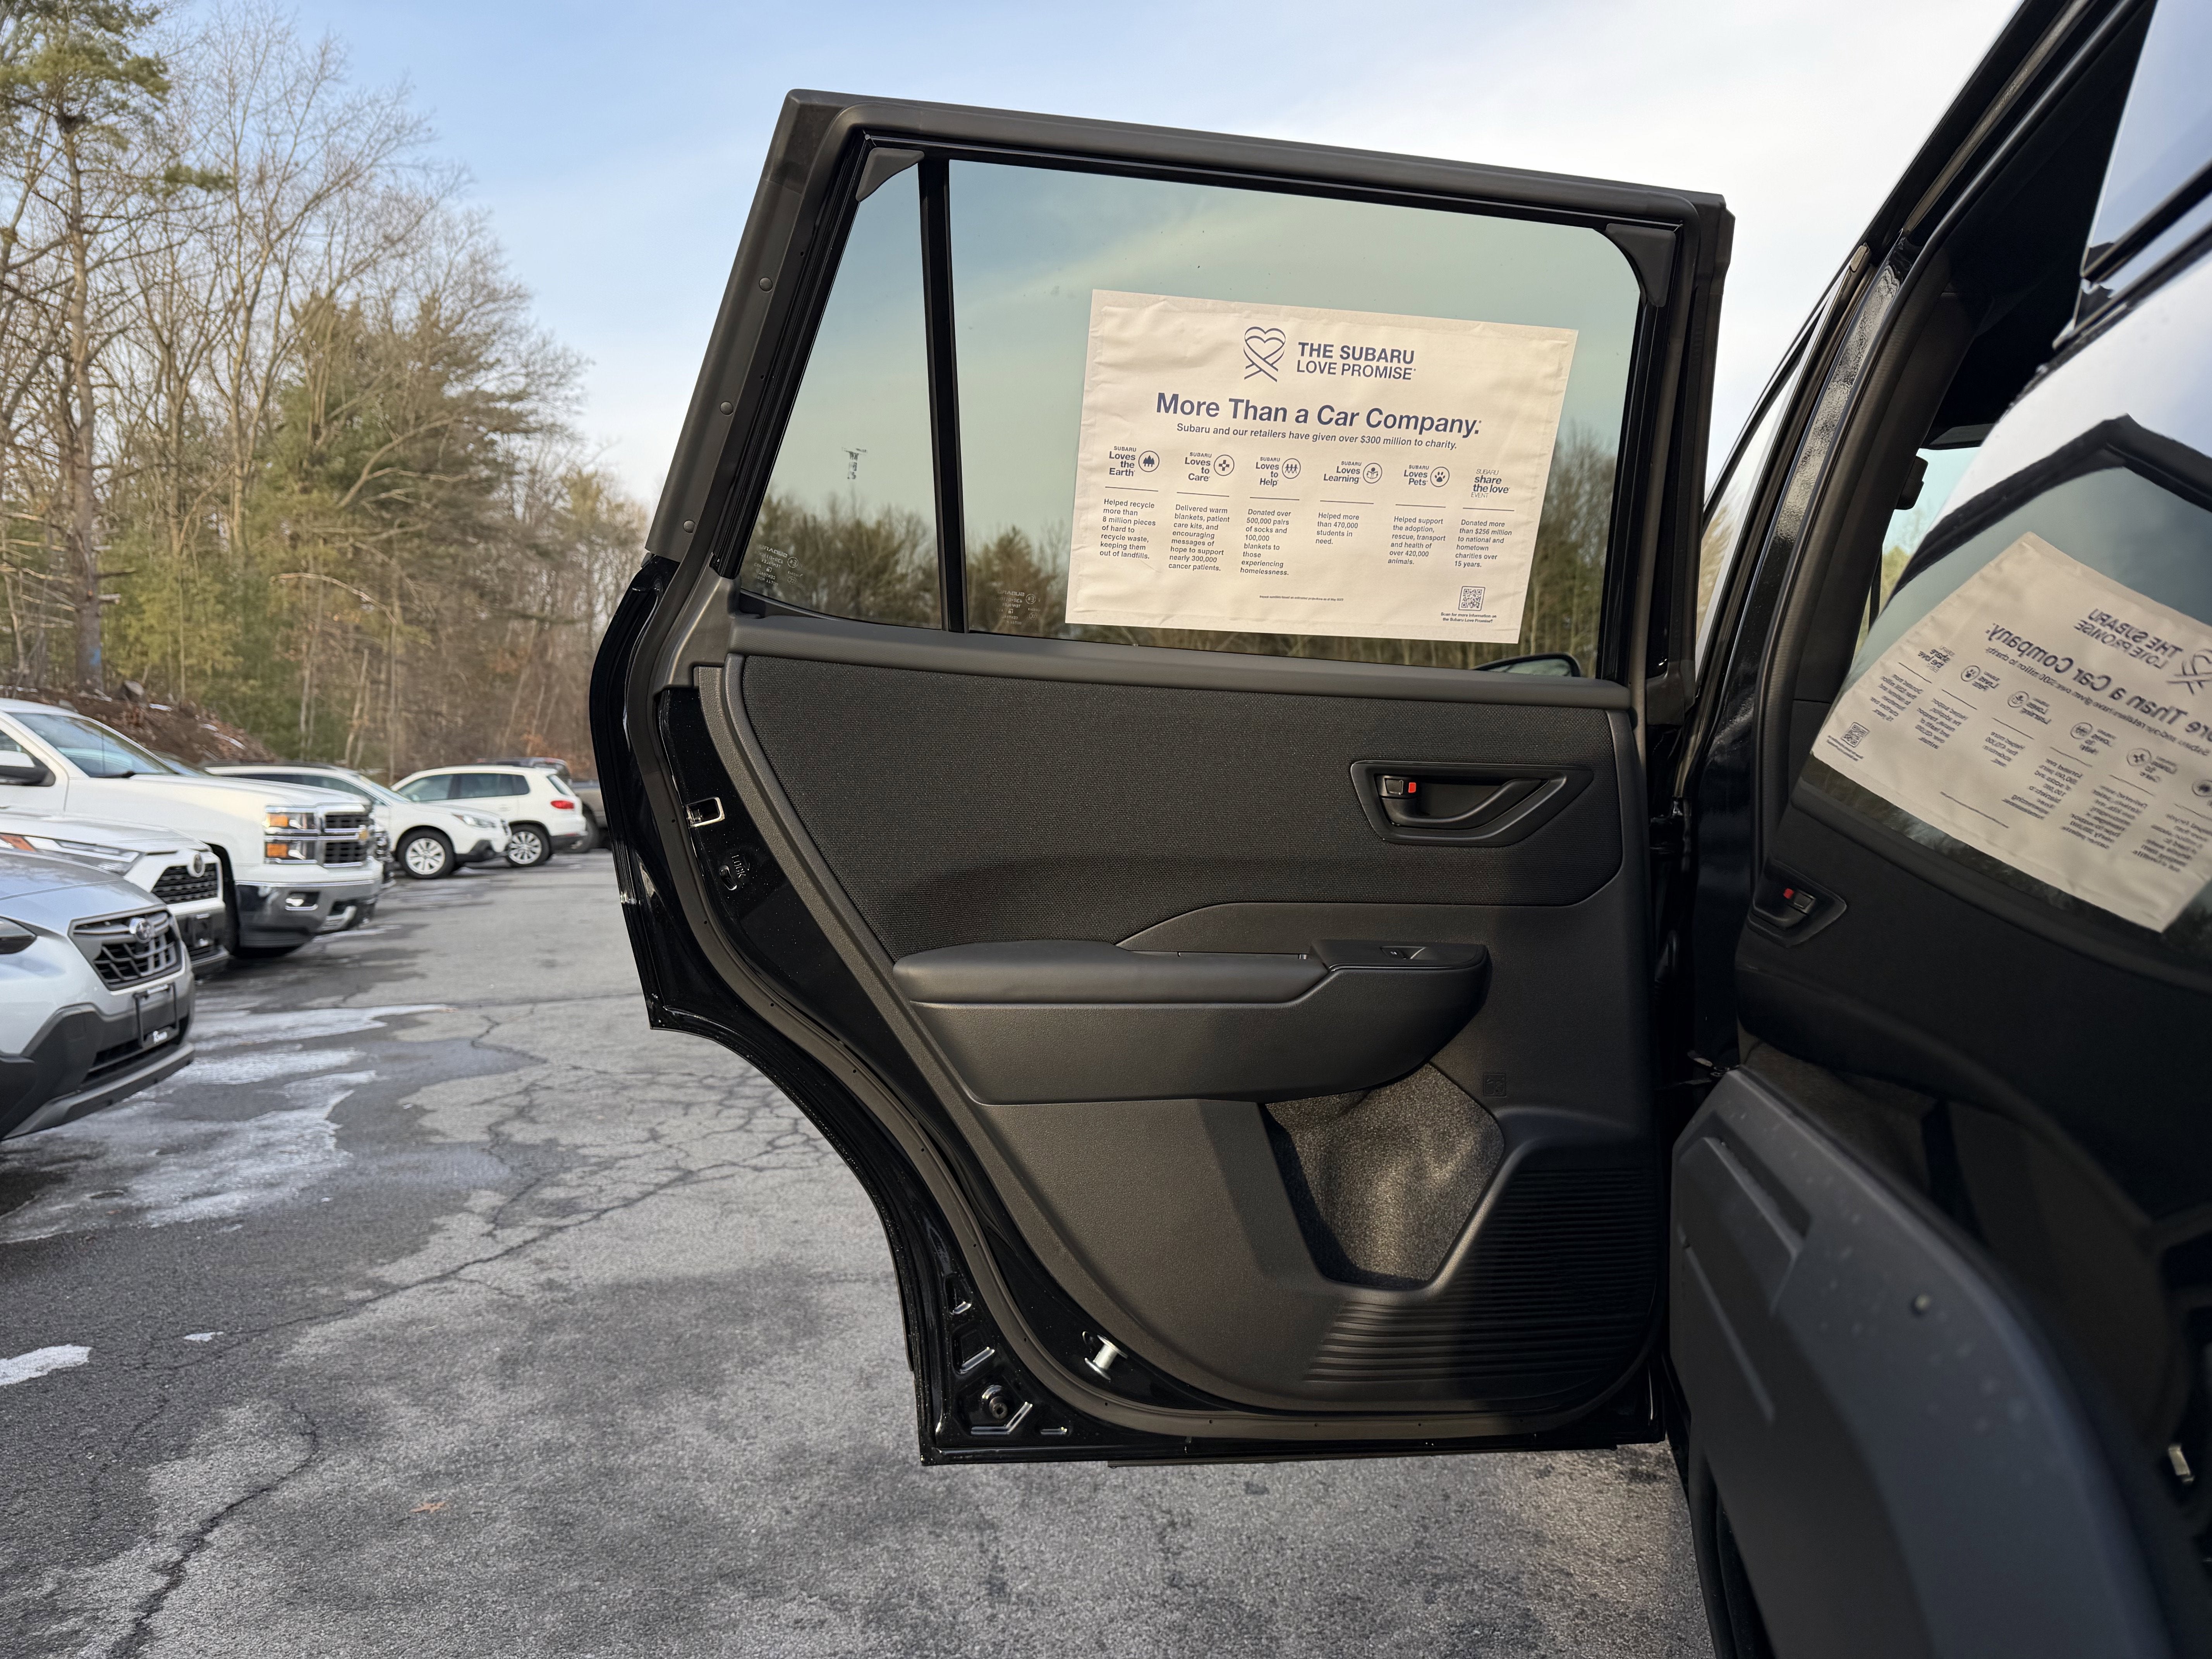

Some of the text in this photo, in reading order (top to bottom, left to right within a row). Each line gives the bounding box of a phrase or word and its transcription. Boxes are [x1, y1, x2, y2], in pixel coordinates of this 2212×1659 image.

[1298, 342, 1414, 364] THE SUBARU
[1297, 360, 1416, 380] LOVE PROMISE
[1157, 393, 1481, 438] More Than a Car Company.
[1177, 423, 1210, 433] Subaru
[1250, 429, 1286, 438] retailers
[1289, 431, 1310, 440] have
[1312, 433, 1336, 442] given
[1360, 435, 1381, 444] $300
[1383, 437, 1411, 445] million
[1425, 440, 1456, 450] charity.
[1109, 451, 1135, 460] Loves
[1185, 457, 1211, 466] Loves
[1336, 466, 1360, 474] Loves
[1404, 470, 1428, 478] Loves
[1474, 475, 1502, 484] share
[1473, 484, 1488, 492] the
[1175, 513, 1205, 522] blankets,
[1173, 531, 1214, 539] encouraging
[1101, 541, 1127, 550] keeping
[1240, 567, 1289, 575] homelessness.
[732, 855, 746, 878] LOCK
